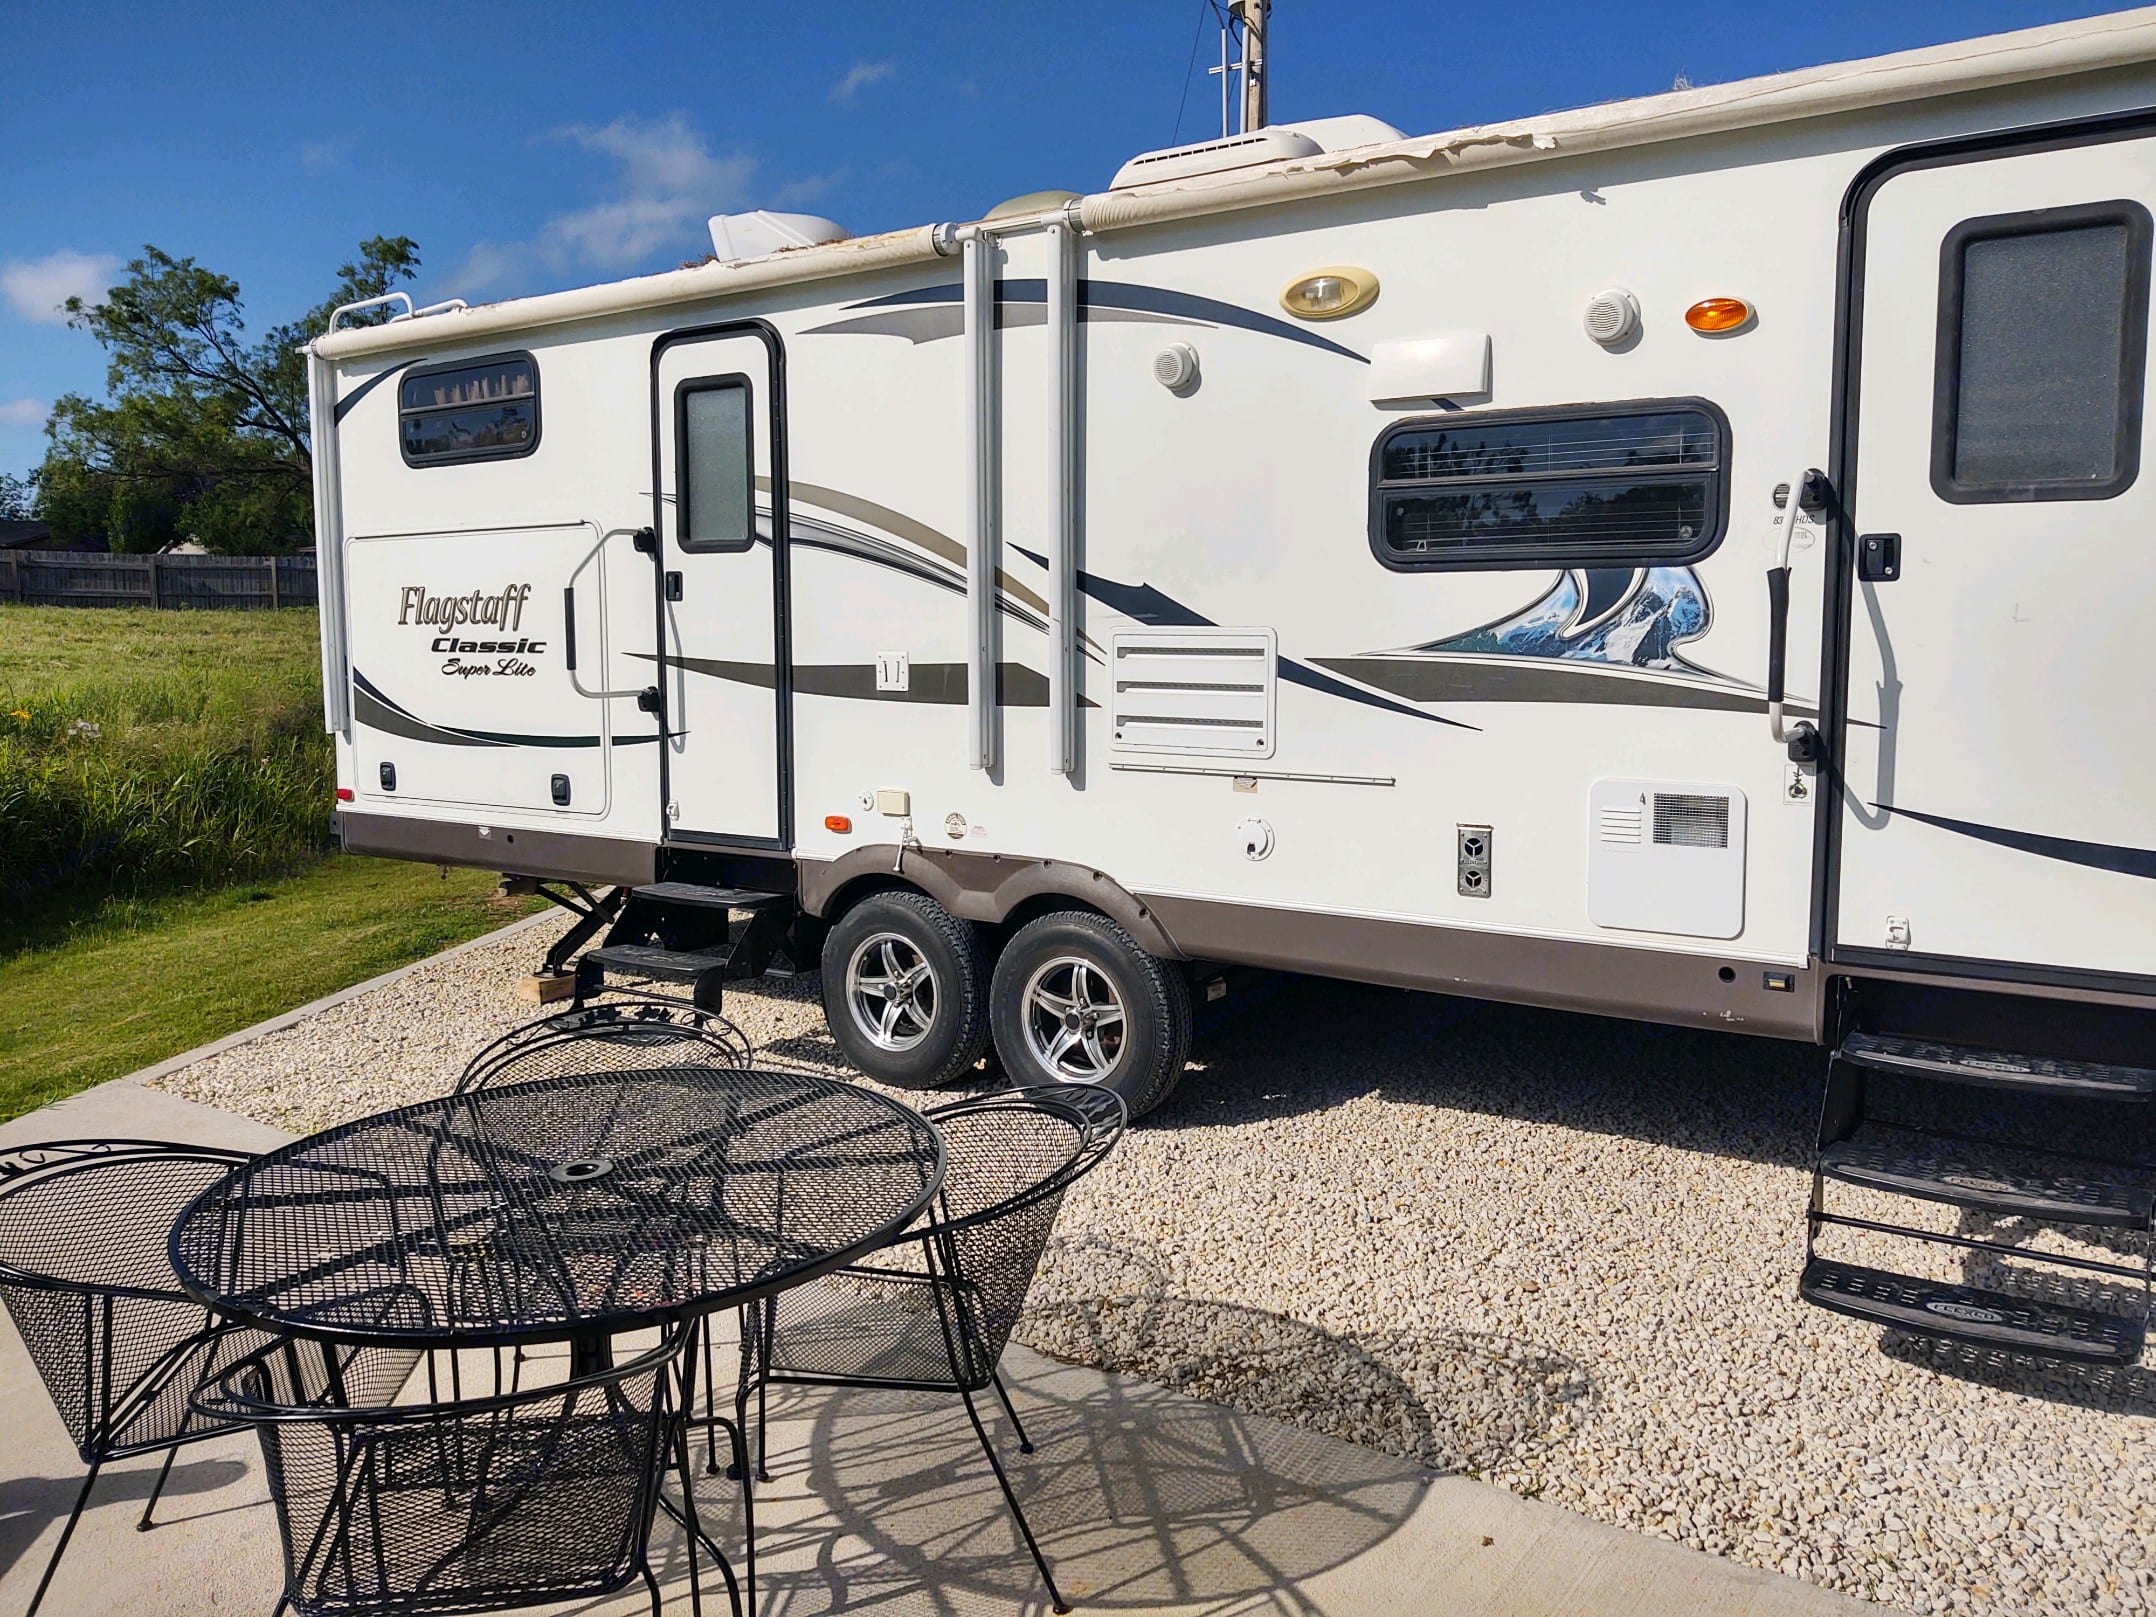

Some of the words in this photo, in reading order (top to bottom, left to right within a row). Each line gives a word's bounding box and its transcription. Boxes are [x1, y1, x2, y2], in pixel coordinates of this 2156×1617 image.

[397, 582, 532, 635] Flagstaff
[431, 637, 547, 654] Classic
[441, 657, 491, 680] Super
[492, 657, 537, 678] Lite
